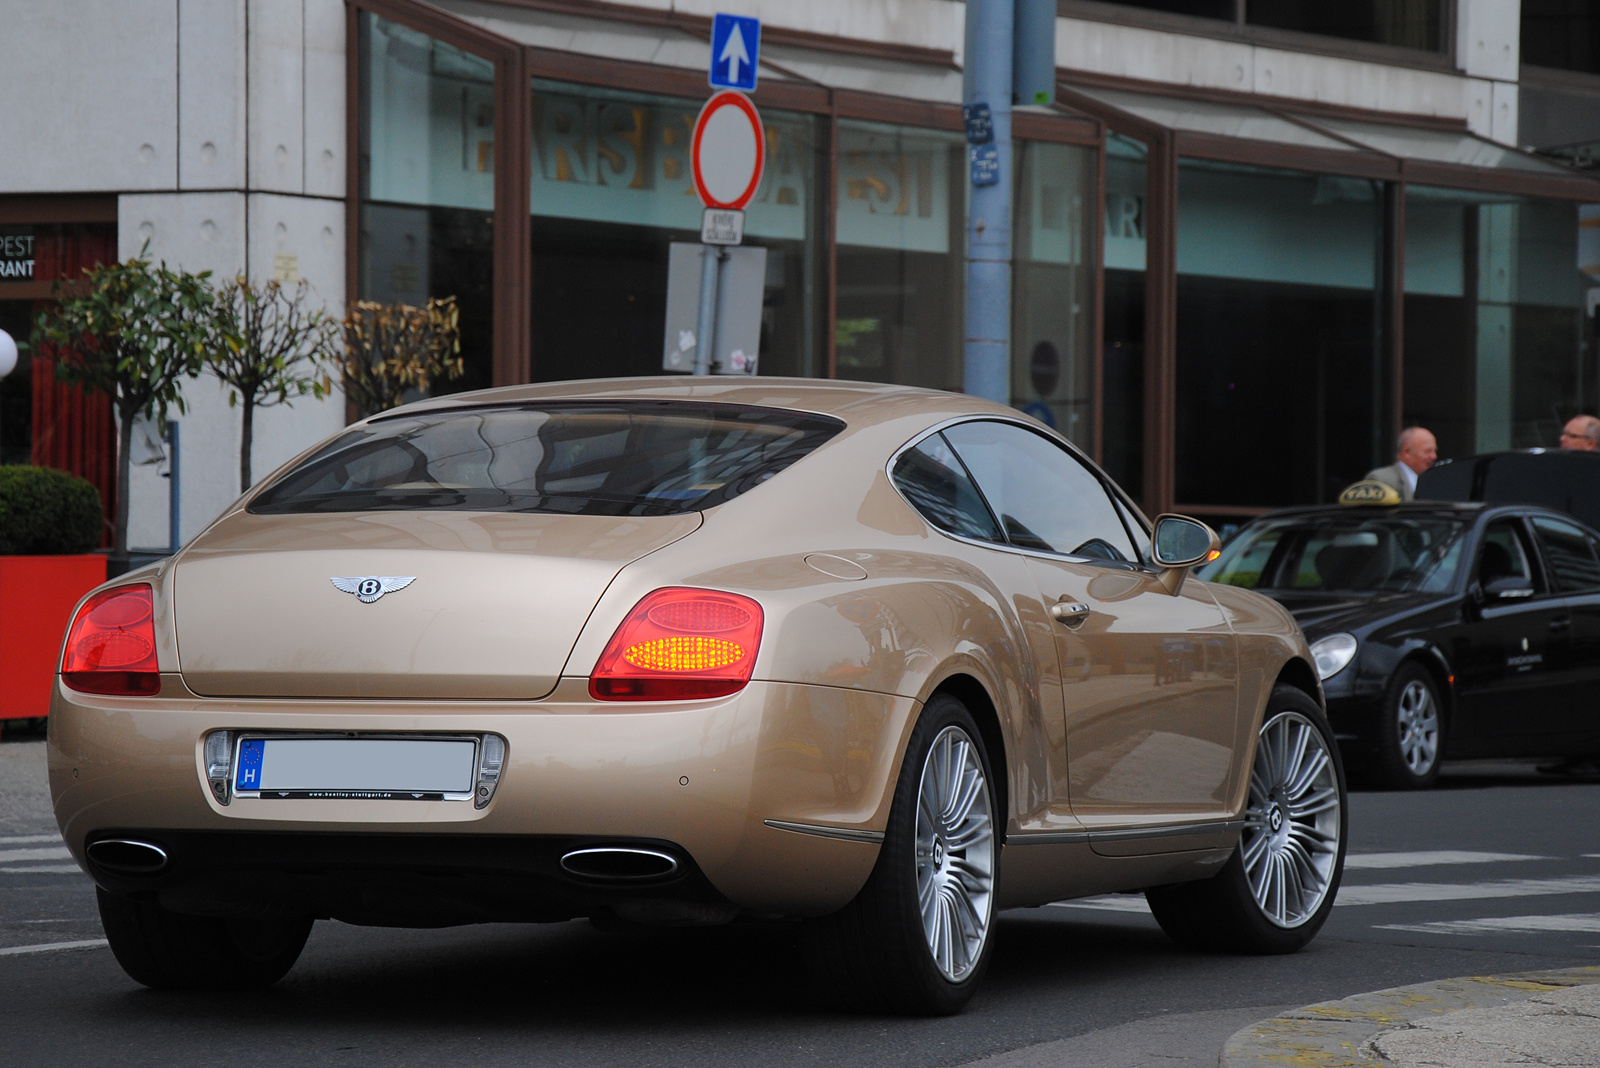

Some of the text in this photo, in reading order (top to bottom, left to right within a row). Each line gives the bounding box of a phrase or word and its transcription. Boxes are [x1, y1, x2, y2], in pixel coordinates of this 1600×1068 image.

[1345, 487, 1384, 499] TAXI
[361, 580, 378, 595] B
[245, 769, 255, 782] H
